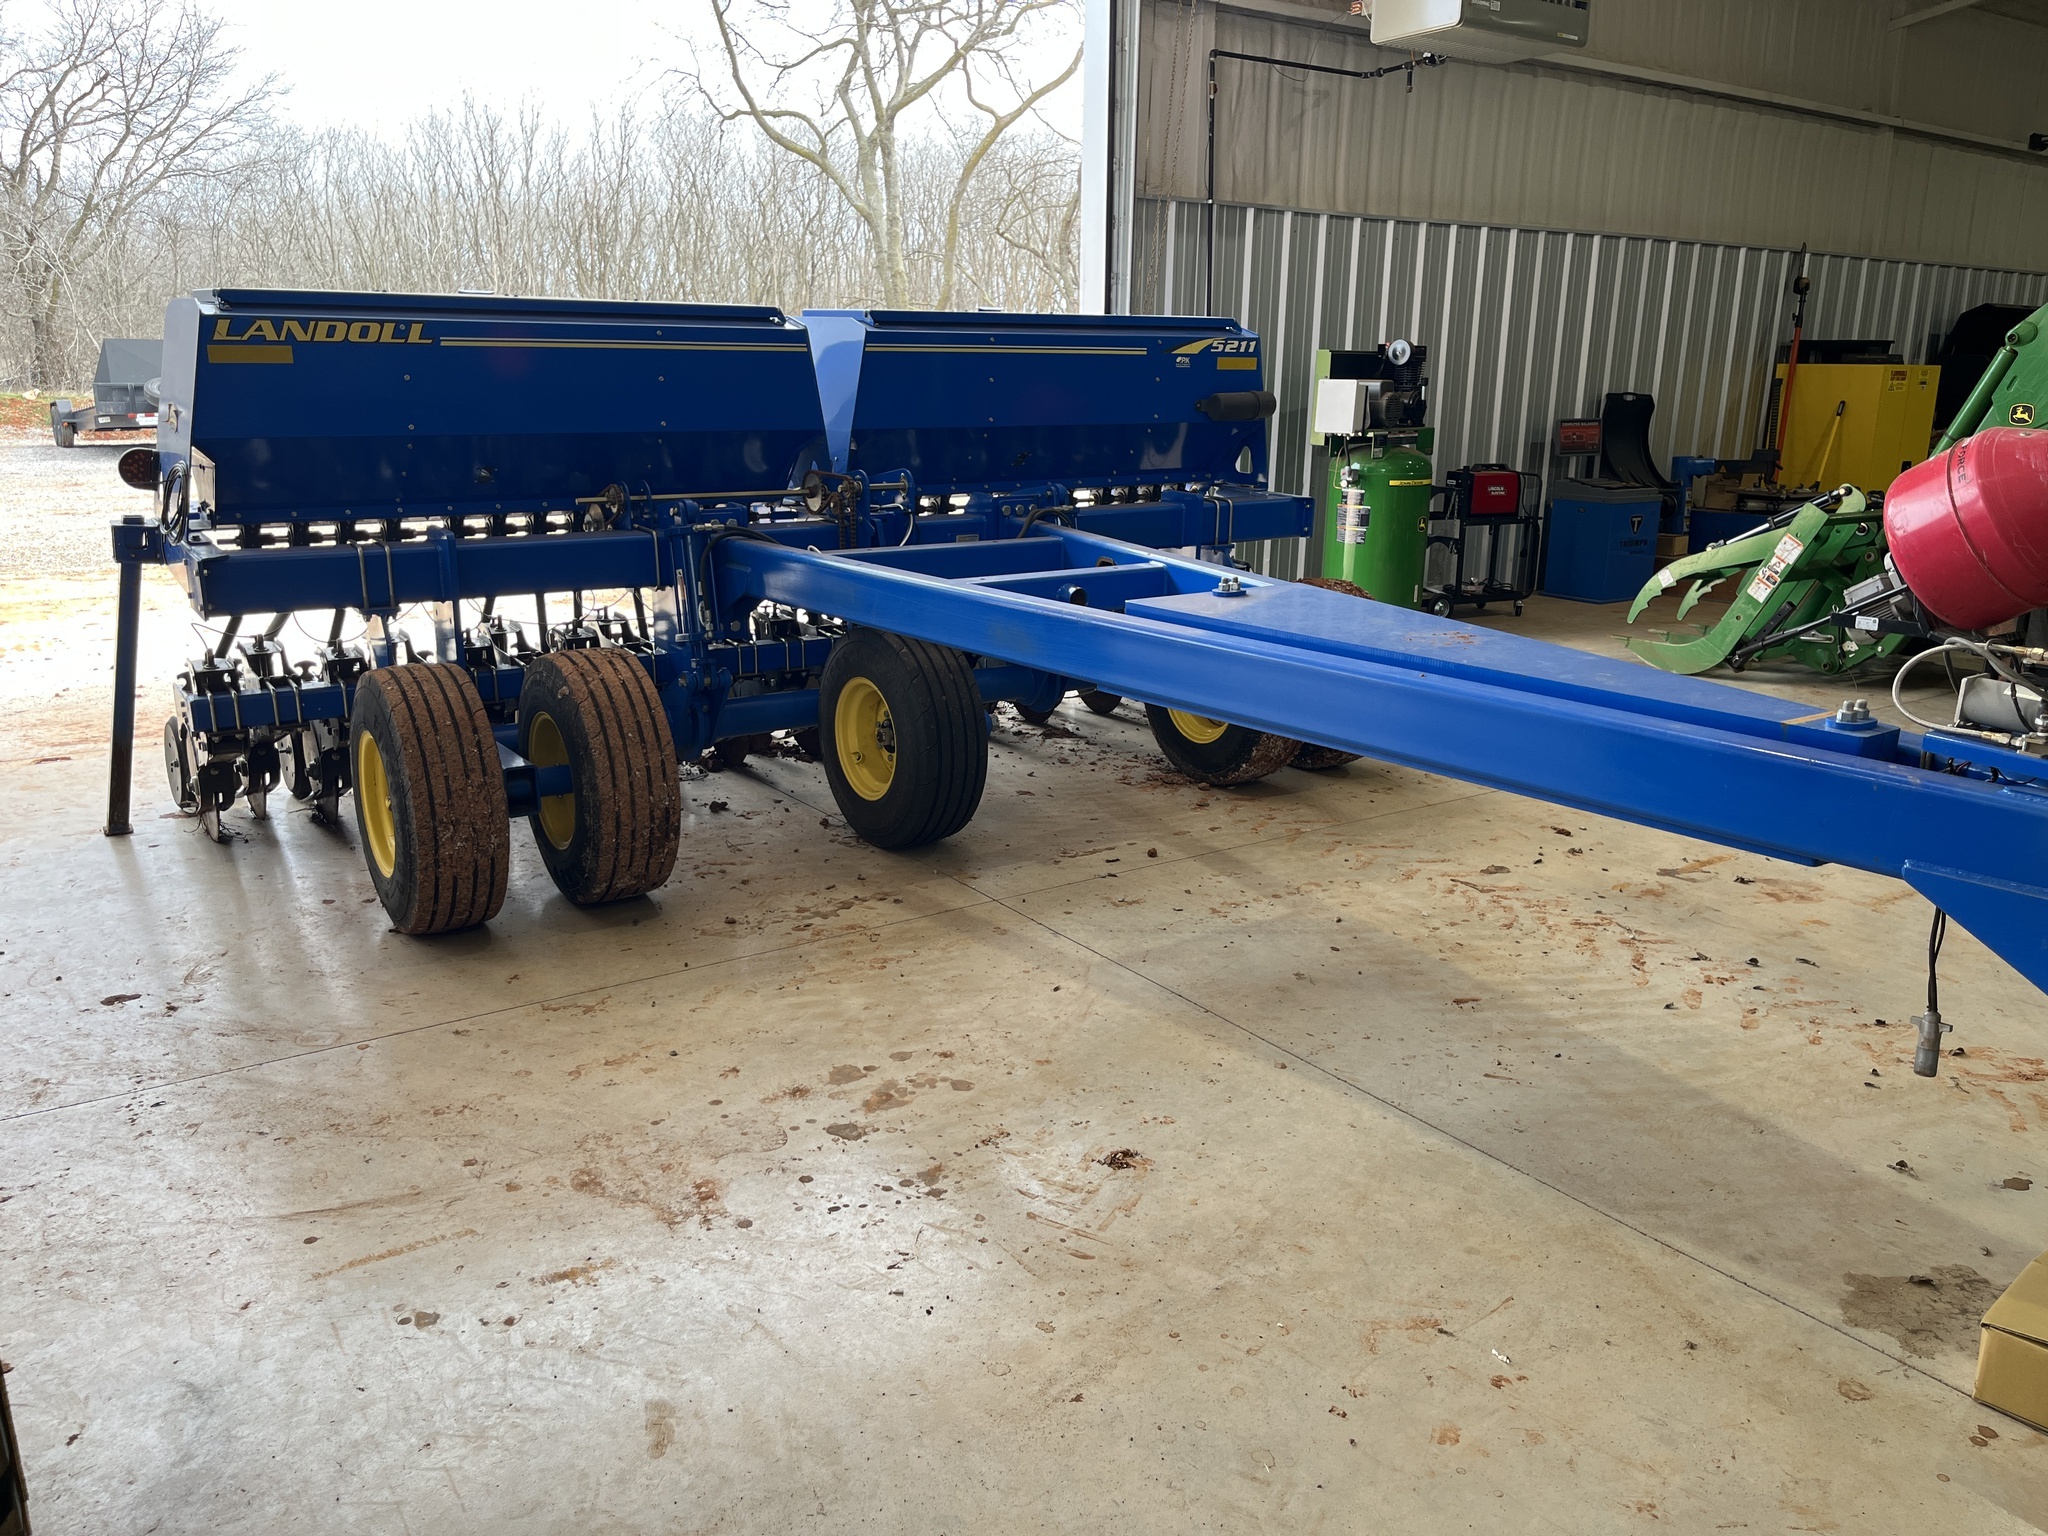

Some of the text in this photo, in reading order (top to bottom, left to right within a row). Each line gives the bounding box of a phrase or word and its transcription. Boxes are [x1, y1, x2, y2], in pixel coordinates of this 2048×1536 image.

[212, 319, 433, 343] LANDOLL
[1210, 340, 1257, 353] 5211
[1620, 538, 1649, 548] TRIUMPH
